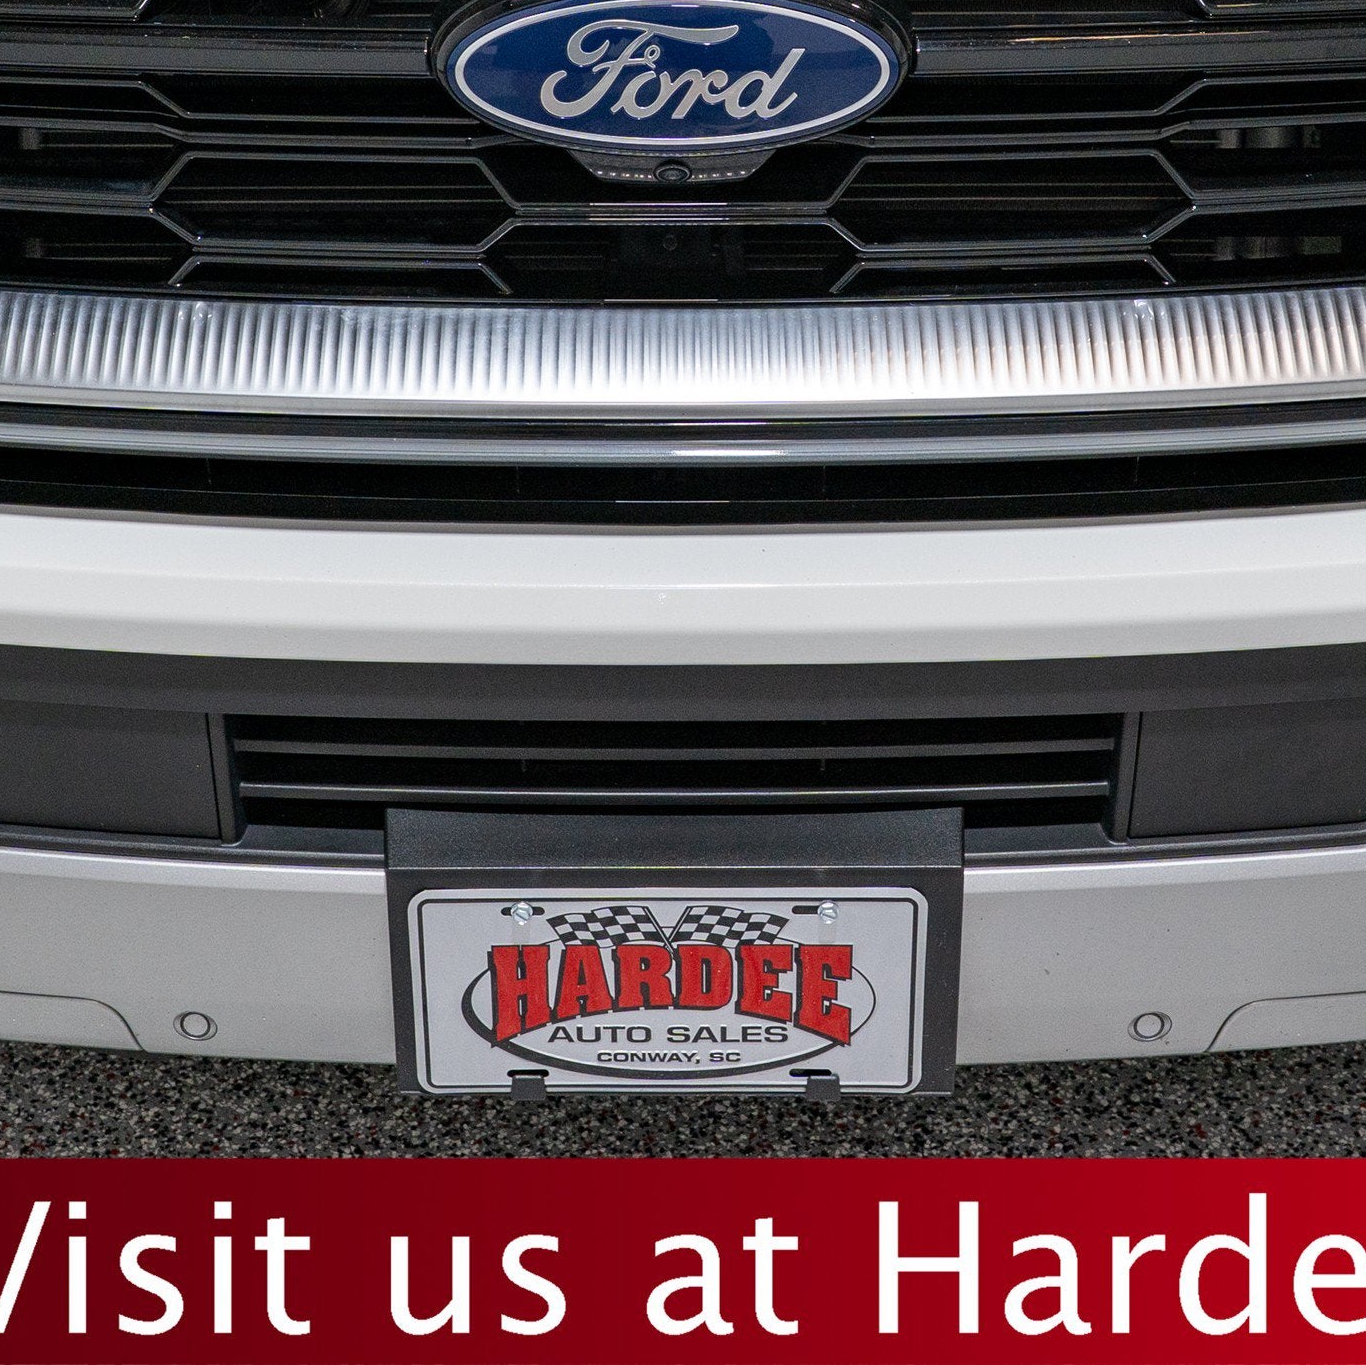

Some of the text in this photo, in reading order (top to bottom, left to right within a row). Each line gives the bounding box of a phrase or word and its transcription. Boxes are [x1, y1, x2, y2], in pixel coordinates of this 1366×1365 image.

[539, 18, 806, 120] Ford
[488, 943, 854, 1047] HARDEE
[547, 1025, 789, 1043] AUTO SALES
[597, 1051, 741, 1065] CONWAY, SC
